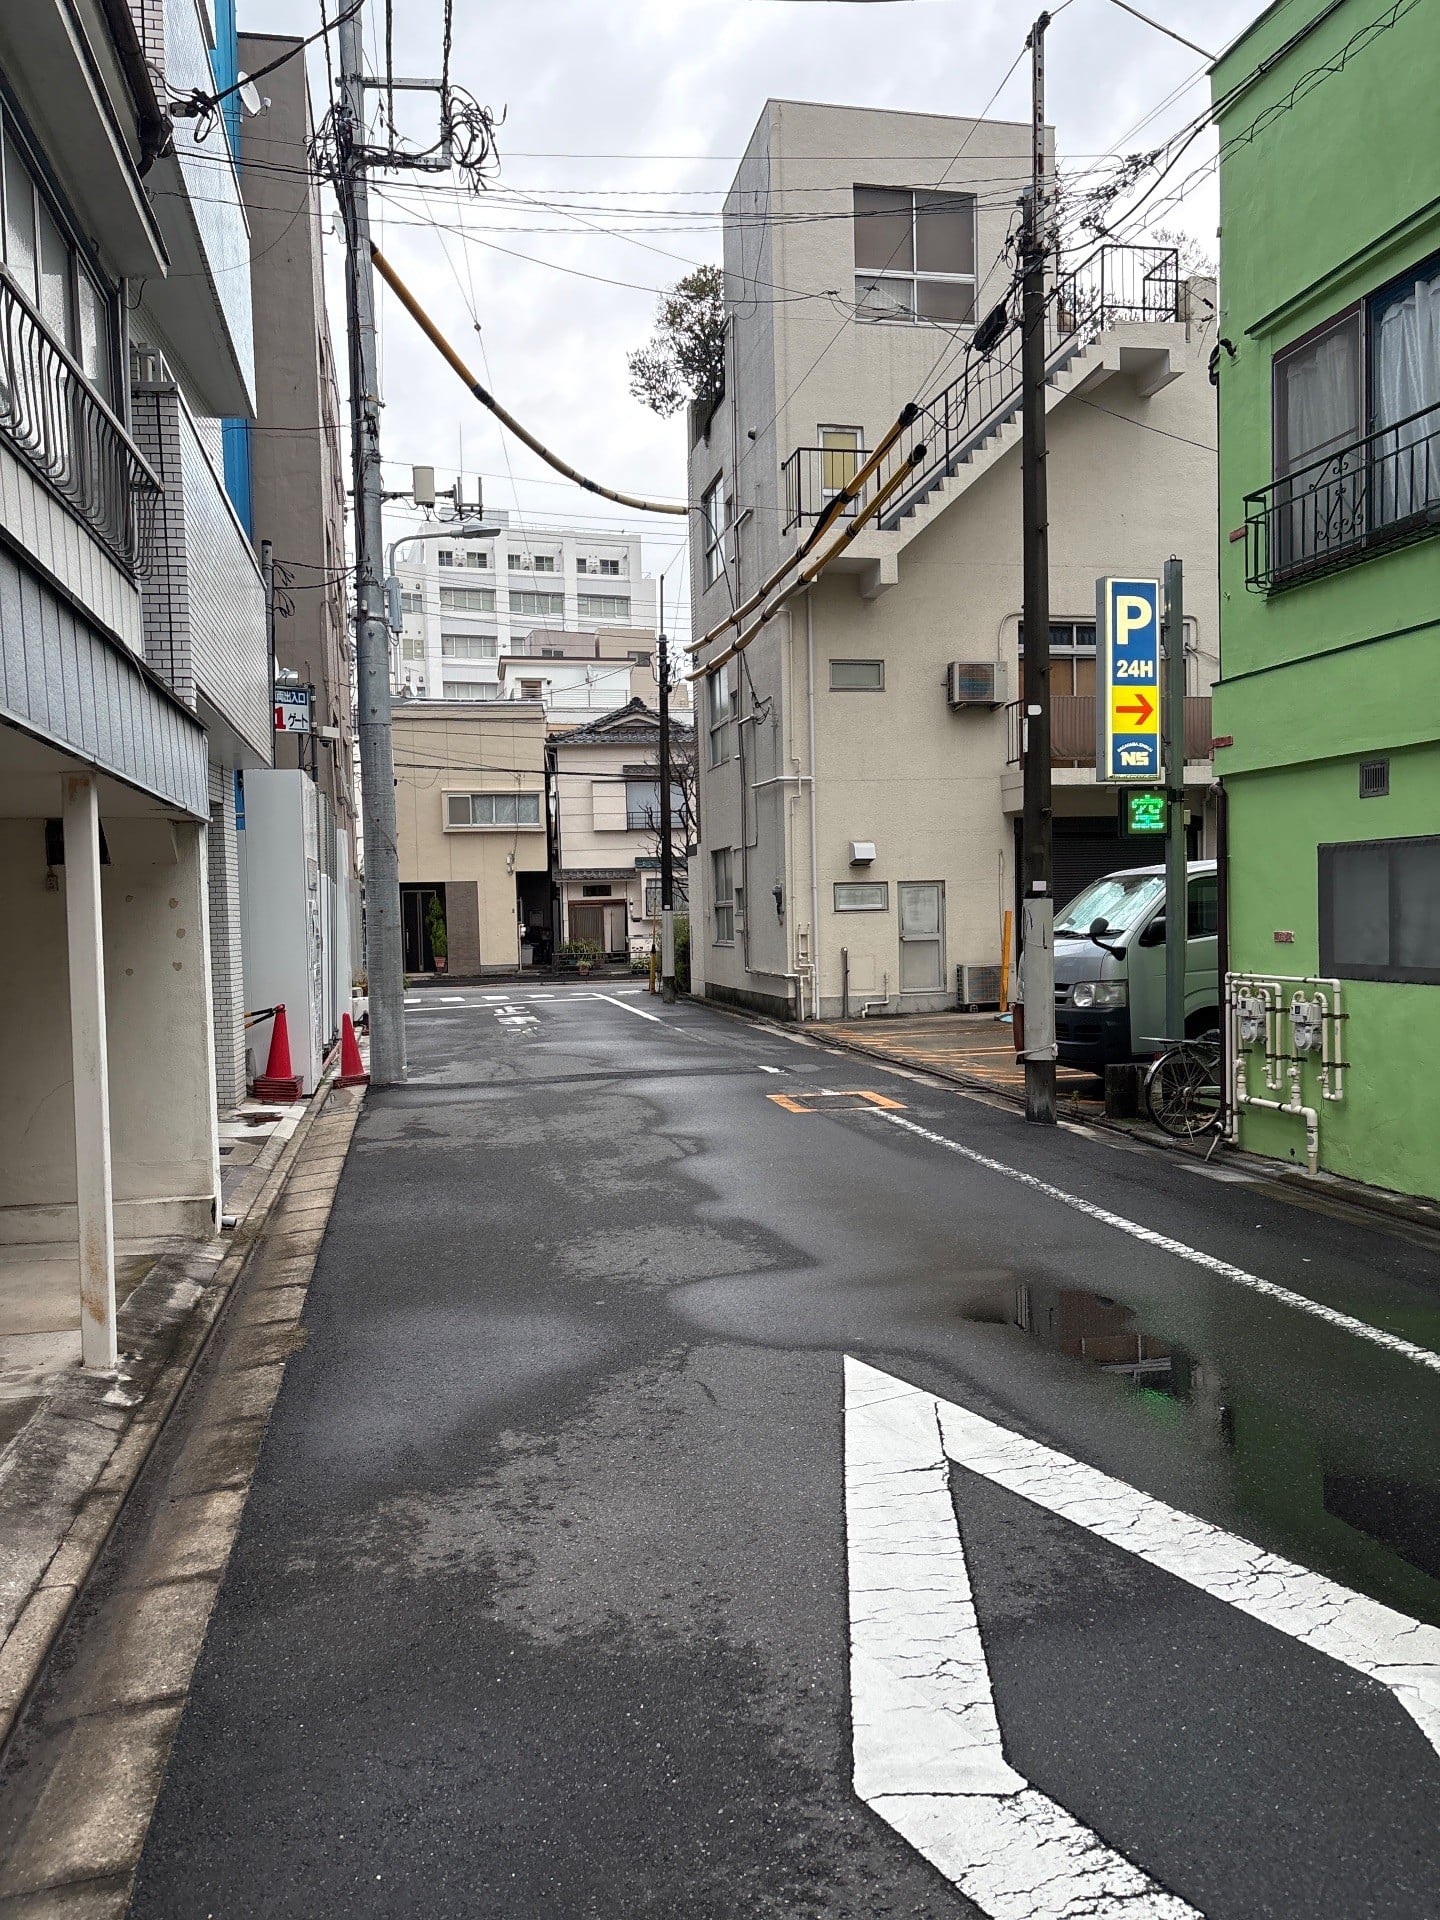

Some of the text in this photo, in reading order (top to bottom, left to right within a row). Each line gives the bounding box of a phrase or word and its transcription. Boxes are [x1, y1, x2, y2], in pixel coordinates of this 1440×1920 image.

[1116, 595, 1153, 645] P
[1116, 659, 1153, 678] 24H
[275, 690, 306, 705] 両出入口
[288, 712, 309, 728] ゲート
[1120, 751, 1150, 766] NS
[1131, 794, 1164, 829] 空
